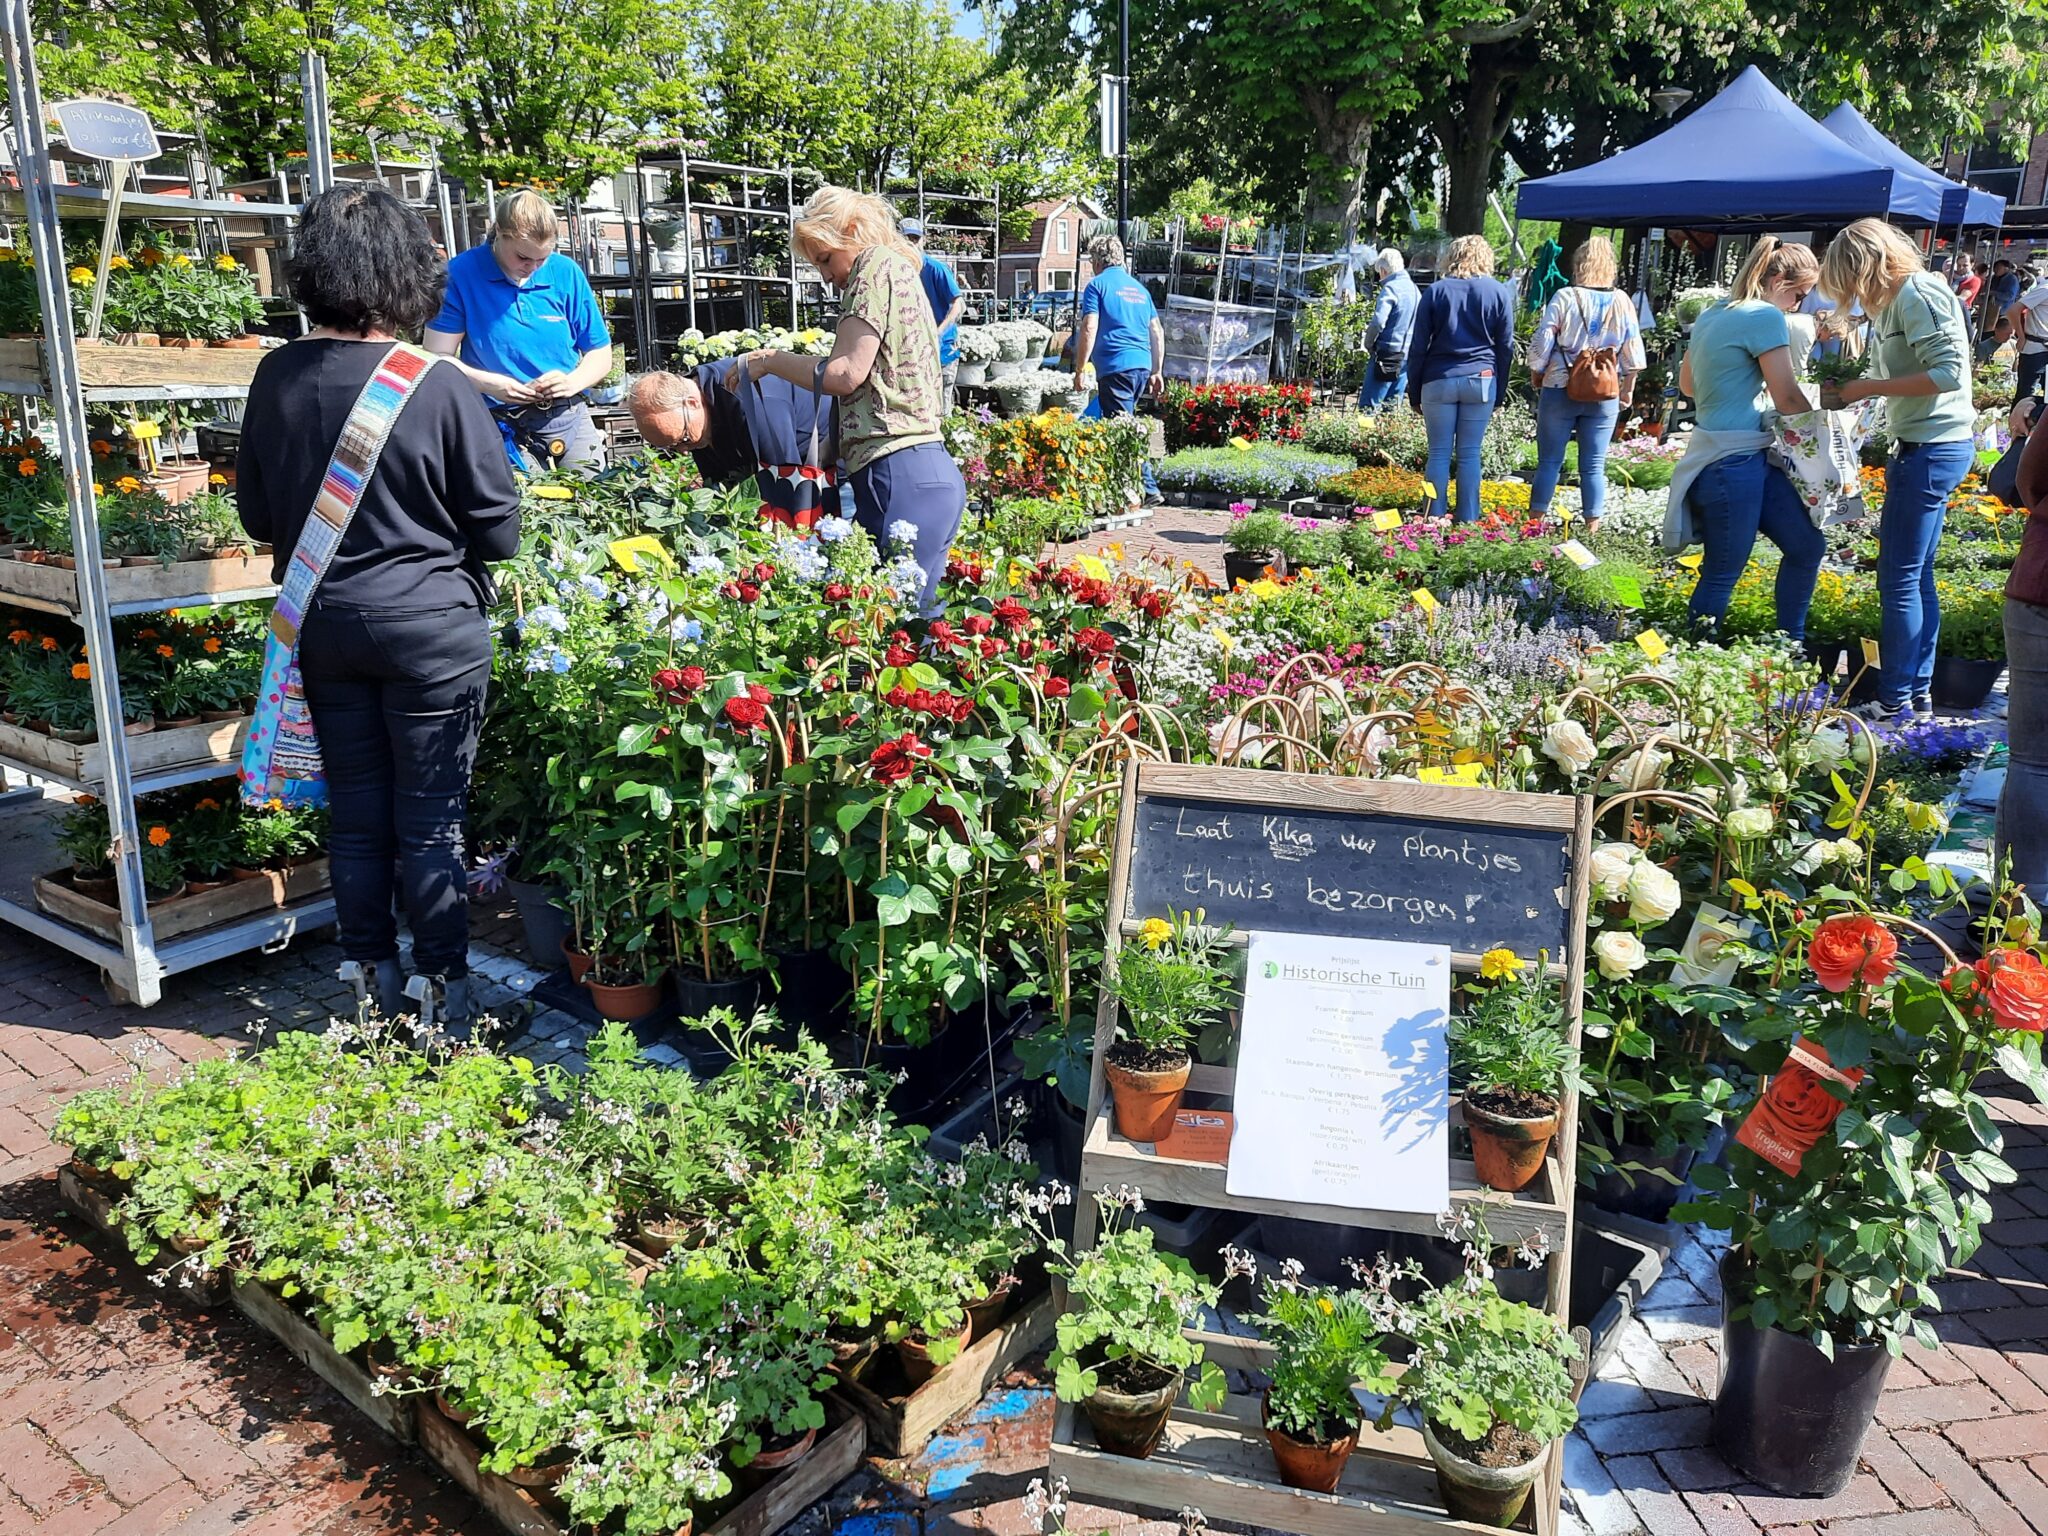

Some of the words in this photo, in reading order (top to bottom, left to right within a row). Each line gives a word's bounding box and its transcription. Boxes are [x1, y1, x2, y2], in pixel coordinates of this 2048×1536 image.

[1176, 806, 1234, 840] Laat
[1262, 815, 1314, 846] Kika
[1340, 833, 1377, 854] uw
[1182, 864, 1273, 899] thuis
[1283, 963, 1382, 985] Historische
[1388, 971, 1426, 988] Tuin
[1755, 1127, 1796, 1160] Tropical
